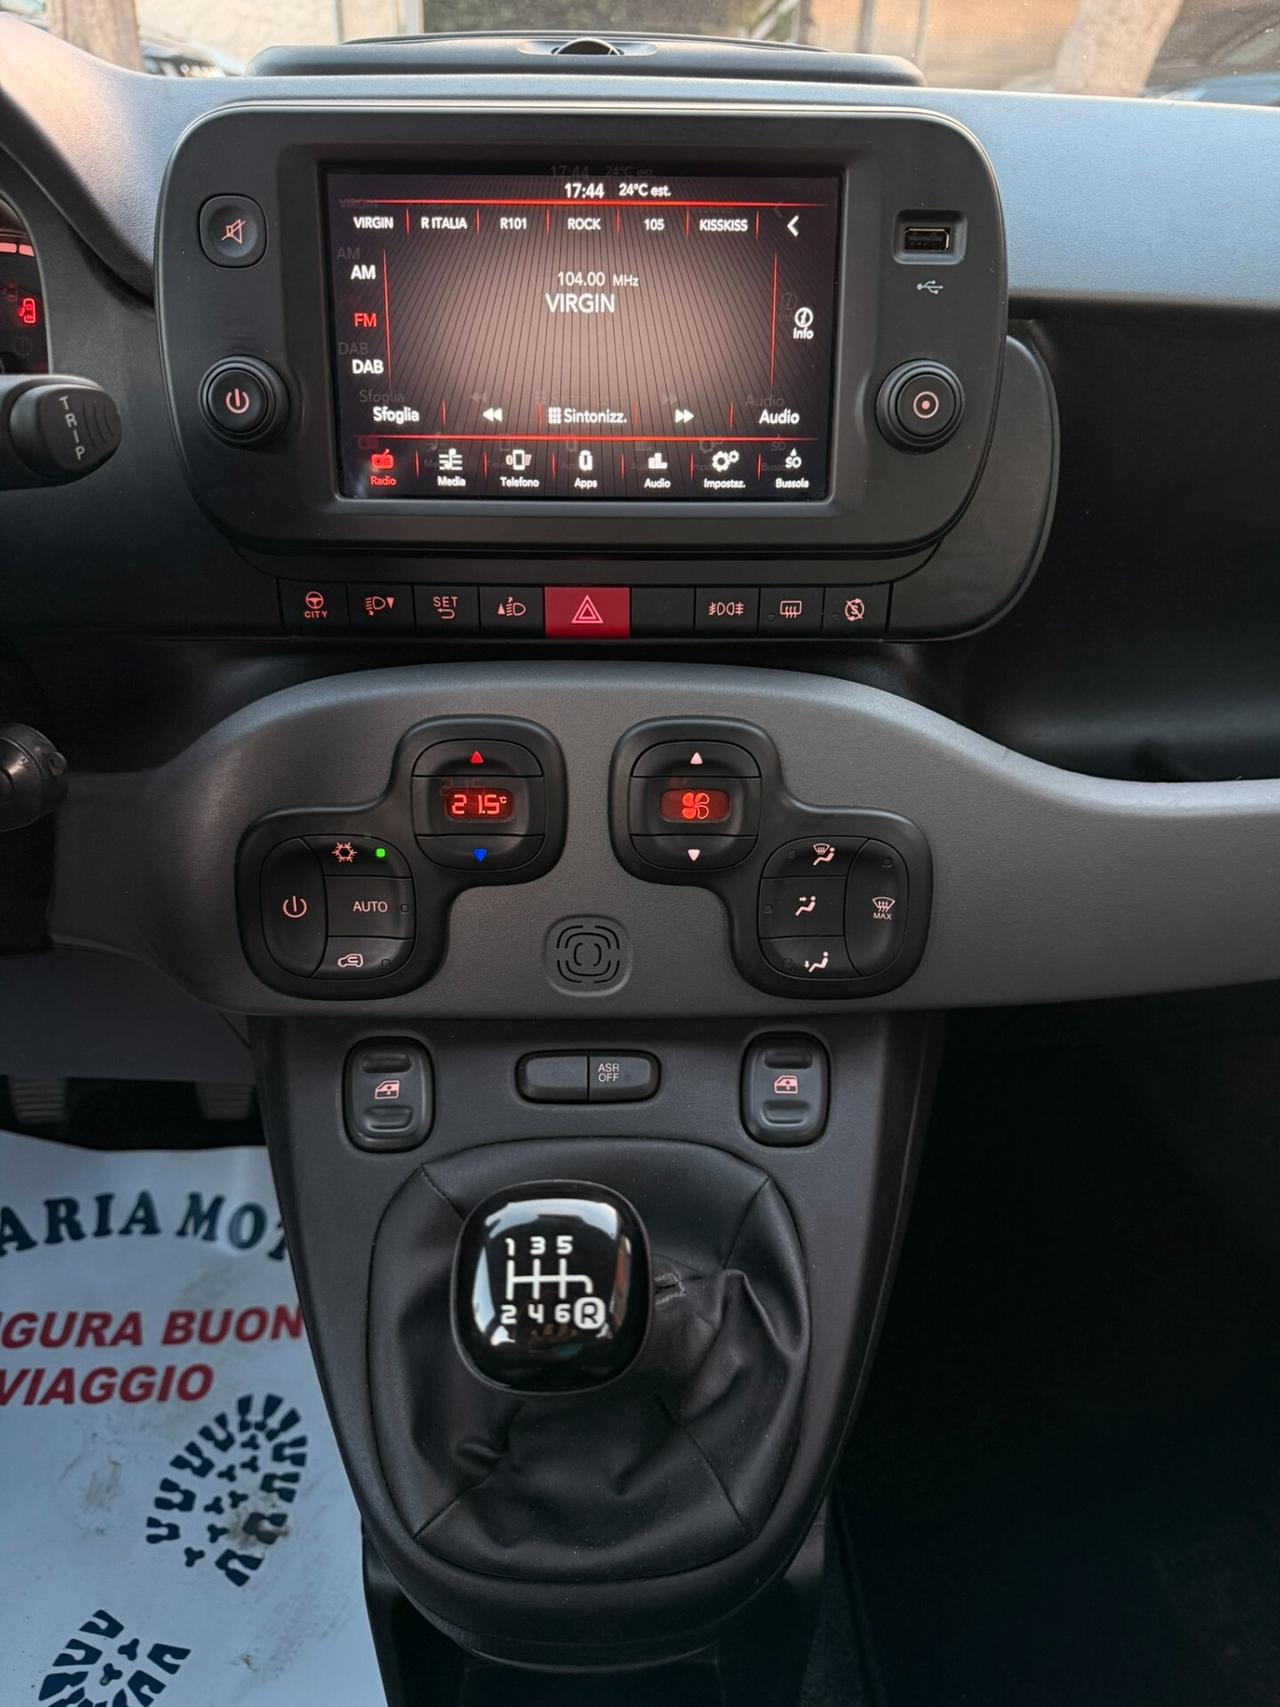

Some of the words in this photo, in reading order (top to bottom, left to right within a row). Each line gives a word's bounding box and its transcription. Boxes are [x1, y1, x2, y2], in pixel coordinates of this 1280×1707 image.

[564, 182, 605, 199] 17:44
[618, 183, 649, 197] 24°C
[650, 185, 672, 197] est.
[353, 216, 394, 230] VIRGIN
[420, 217, 430, 230] R
[431, 217, 468, 230] ITALIA
[499, 217, 527, 230] R101
[567, 218, 601, 231] ROCK
[643, 218, 665, 231] 105
[699, 219, 748, 232] KISSKISS
[350, 265, 376, 280] AM
[557, 272, 606, 287] 104.00
[612, 274, 639, 287] MHz
[545, 293, 616, 314] VIRGIN
[354, 313, 377, 328] FM
[792, 327, 815, 340] Info
[351, 359, 384, 375] DAB
[372, 406, 420, 425] Sfoglia
[563, 409, 628, 425] Sintonizz.
[758, 408, 801, 425] Audio
[58, 395, 86, 461] TRIP
[370, 475, 397, 487] Radio
[437, 475, 466, 488] Media
[501, 475, 540, 488] Telefono
[574, 477, 598, 490] Apps
[644, 477, 671, 489] Audio
[703, 477, 746, 490] Impostaz.
[775, 477, 810, 489] Bussola
[432, 596, 458, 608] SET
[304, 610, 328, 619] CITY
[352, 900, 388, 914] AUTO
[873, 912, 892, 921] MAX
[598, 1063, 620, 1073] ASR
[598, 1072, 620, 1083] OFF
[504, 1237, 516, 1257] 1
[529, 1235, 547, 1256] 3
[556, 1235, 574, 1255] 5
[500, 1305, 518, 1325] 2
[527, 1303, 545, 1324] 4
[554, 1303, 571, 1324] 6
[0, 1311, 144, 1349] GURA
[161, 1305, 303, 1346] BUON
[0, 1363, 215, 1406] VIAGGIO
